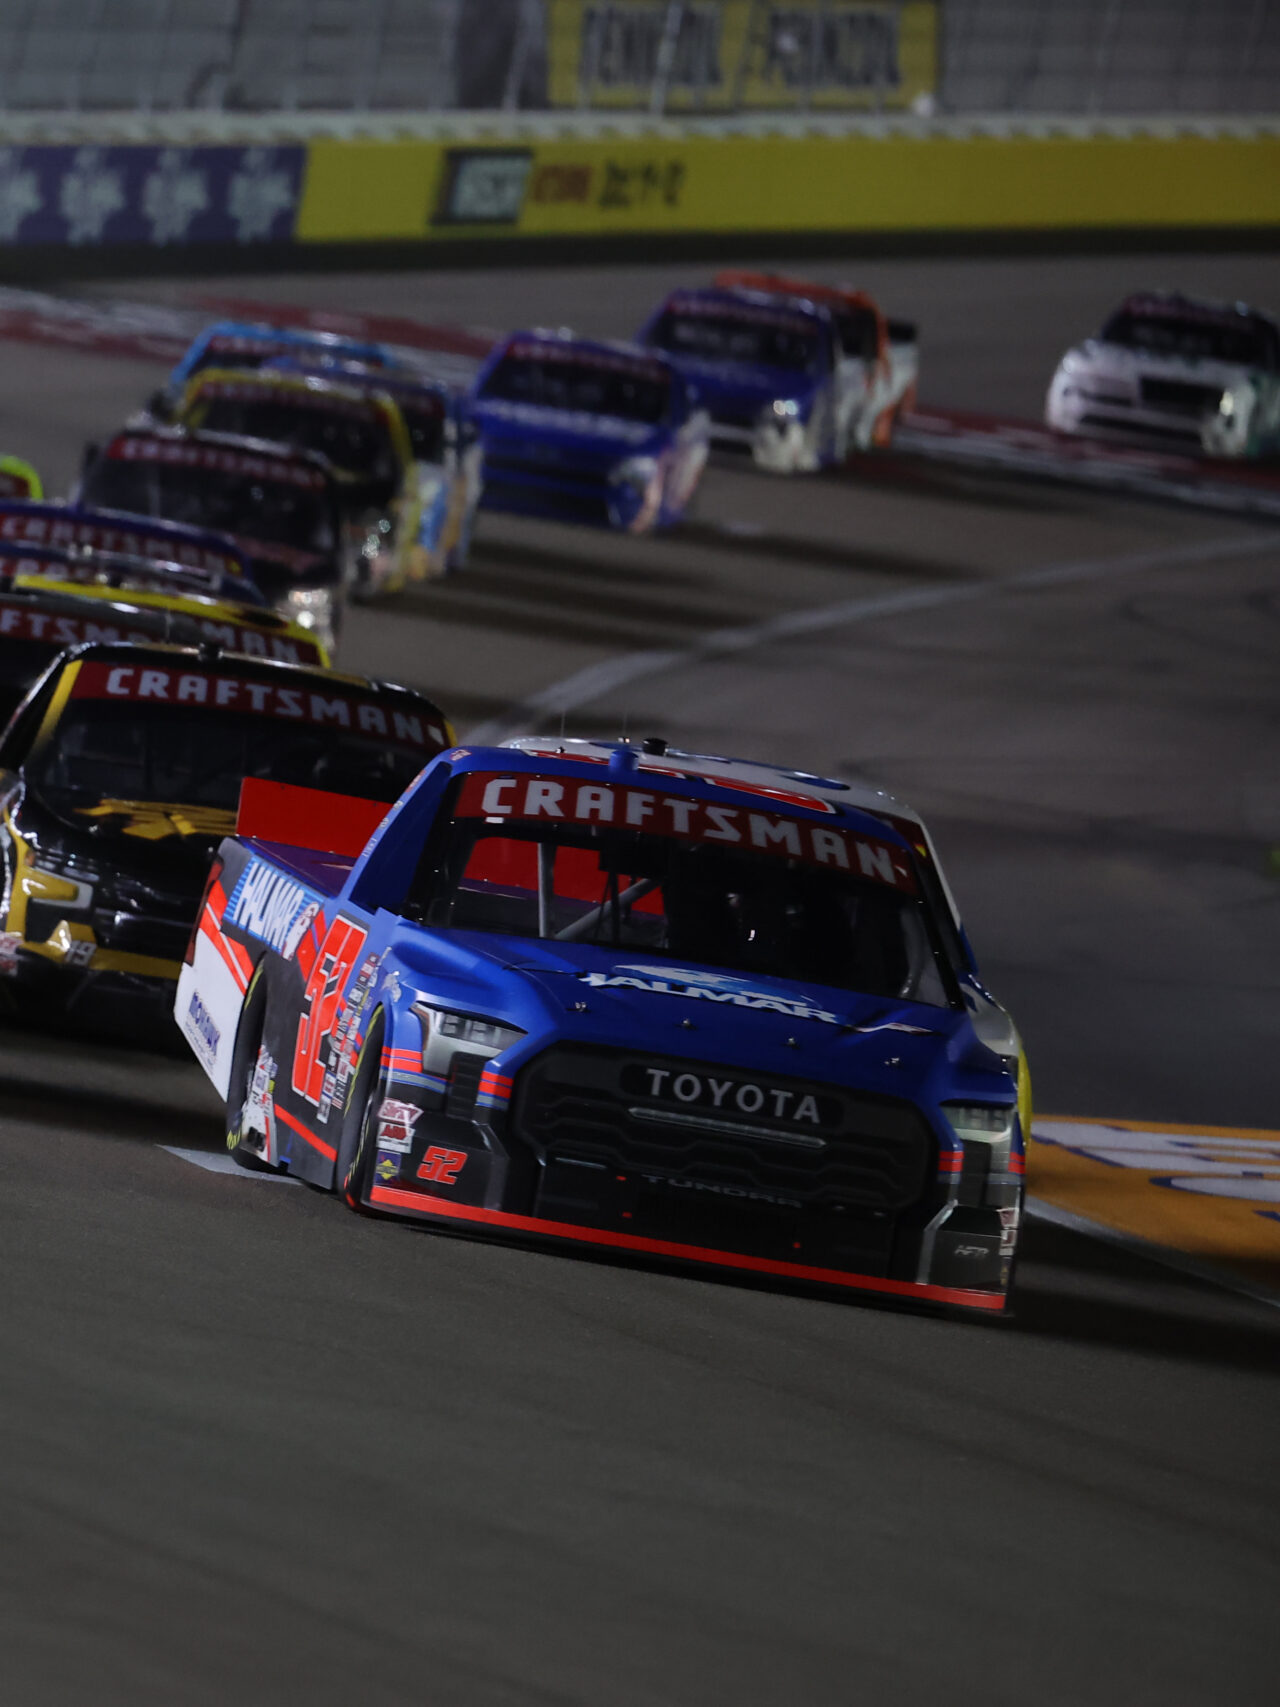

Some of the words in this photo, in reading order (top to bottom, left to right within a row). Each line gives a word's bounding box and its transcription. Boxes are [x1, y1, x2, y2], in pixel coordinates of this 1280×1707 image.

[106, 666, 425, 745] CRAFTSMAN
[480, 778, 897, 885] CRAFTSMAN
[645, 1067, 821, 1124] TOYOTA
[416, 1145, 468, 1185] 52
[640, 1173, 803, 1208] TUNDRA
